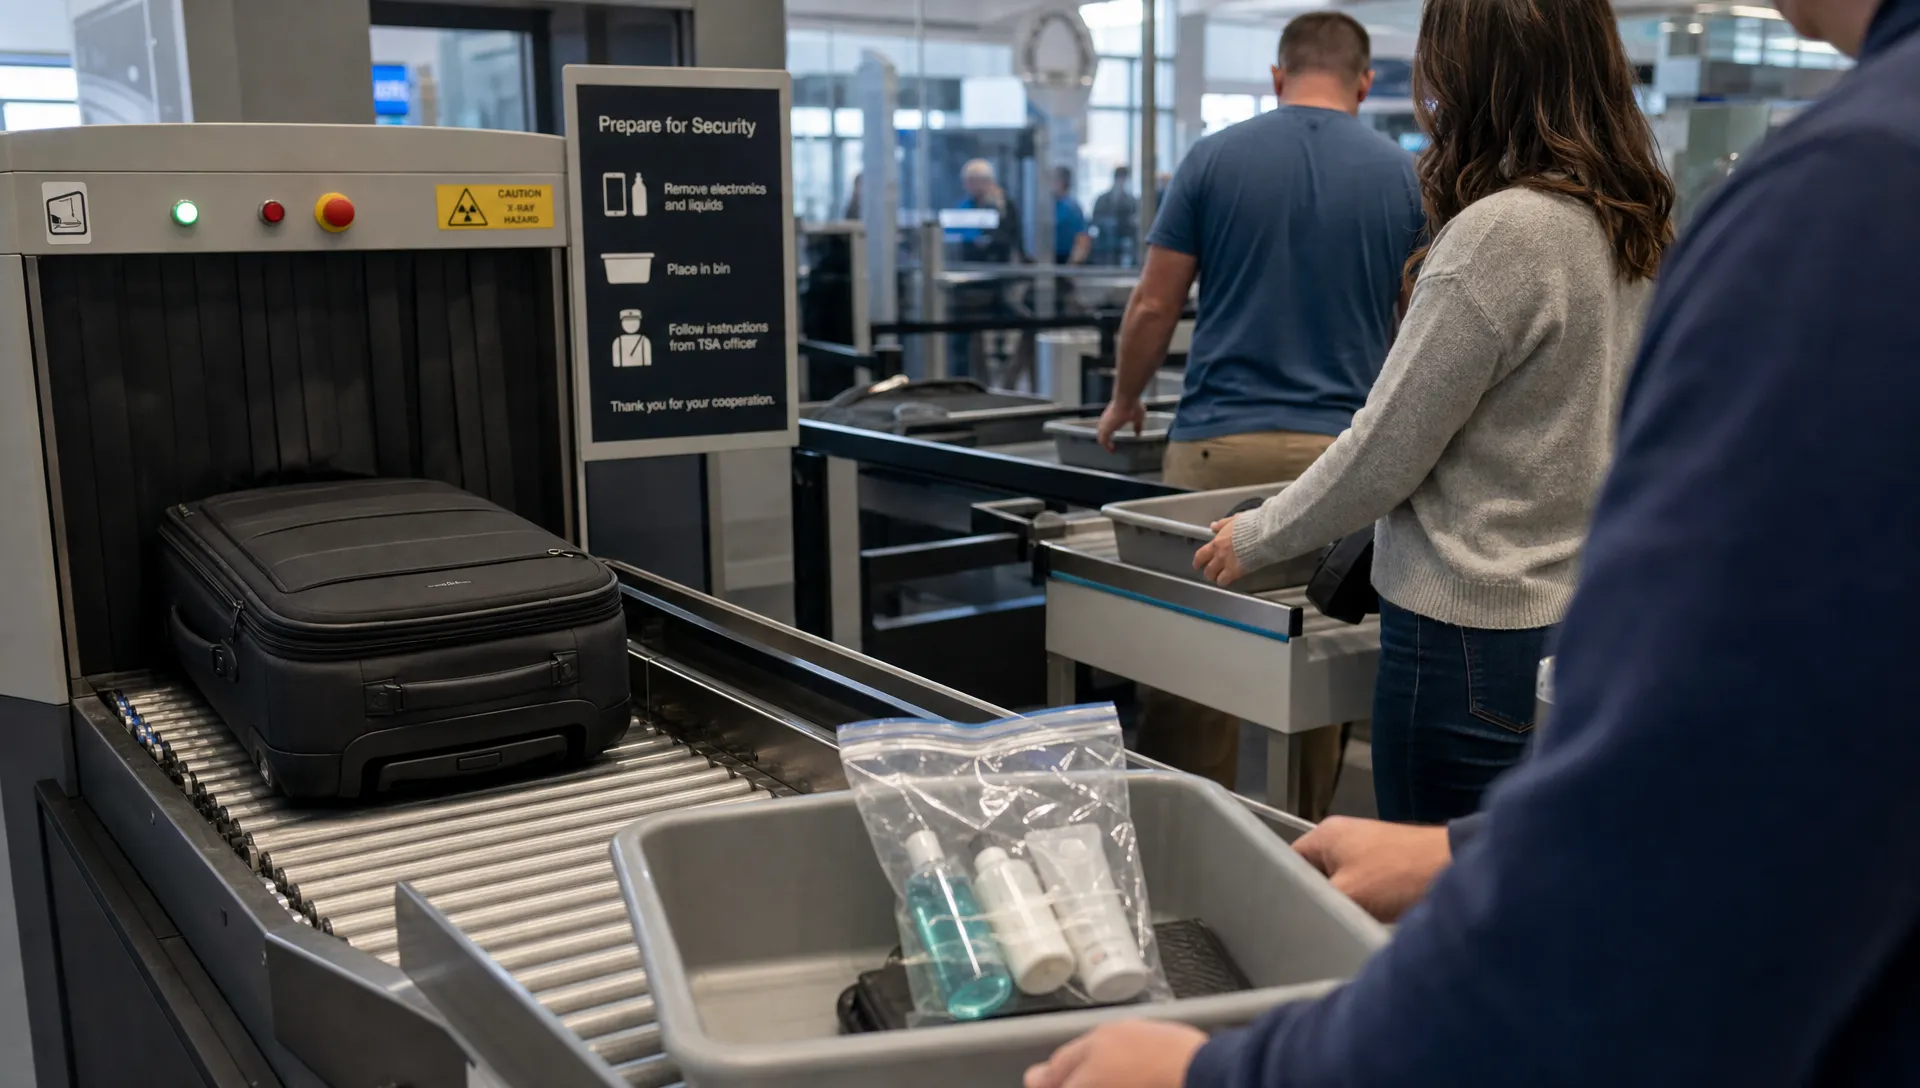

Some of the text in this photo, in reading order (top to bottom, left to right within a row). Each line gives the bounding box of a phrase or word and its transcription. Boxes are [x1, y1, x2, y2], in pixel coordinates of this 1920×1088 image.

[599, 115, 757, 138] Prepare for Security
[498, 189, 542, 198] CAUTION
[664, 183, 767, 195] Remove electronics
[665, 199, 723, 213] and liquids
[504, 216, 540, 224] HAZARD
[667, 262, 731, 275] Place in bin
[669, 321, 768, 336] Follow instructions
[669, 337, 757, 351] from TSA officer
[610, 394, 775, 414] Thank you for your cooperation.
